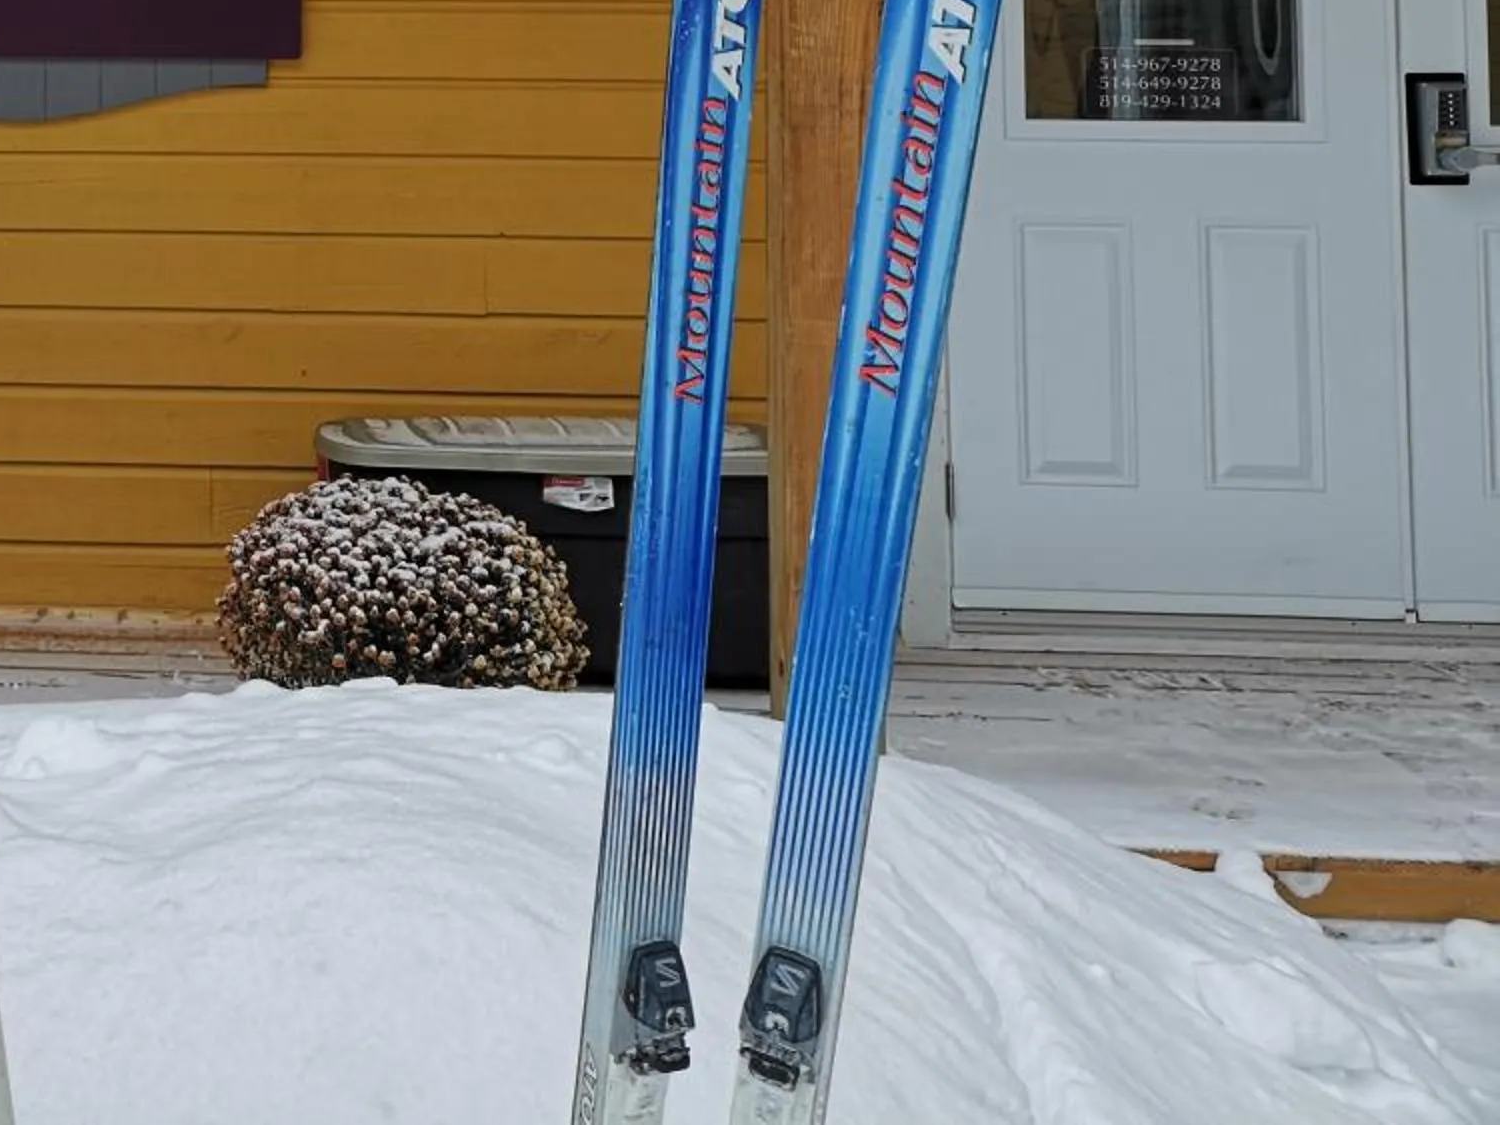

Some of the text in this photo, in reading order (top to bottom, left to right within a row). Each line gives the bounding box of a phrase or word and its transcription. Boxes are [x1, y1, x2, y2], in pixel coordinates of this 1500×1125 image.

[1099, 57, 1222, 72] 514-967-9278
[1099, 76, 1222, 91] 514-649-9278
[673, 96, 729, 404] Mountain
[859, 69, 947, 397] Mountain
